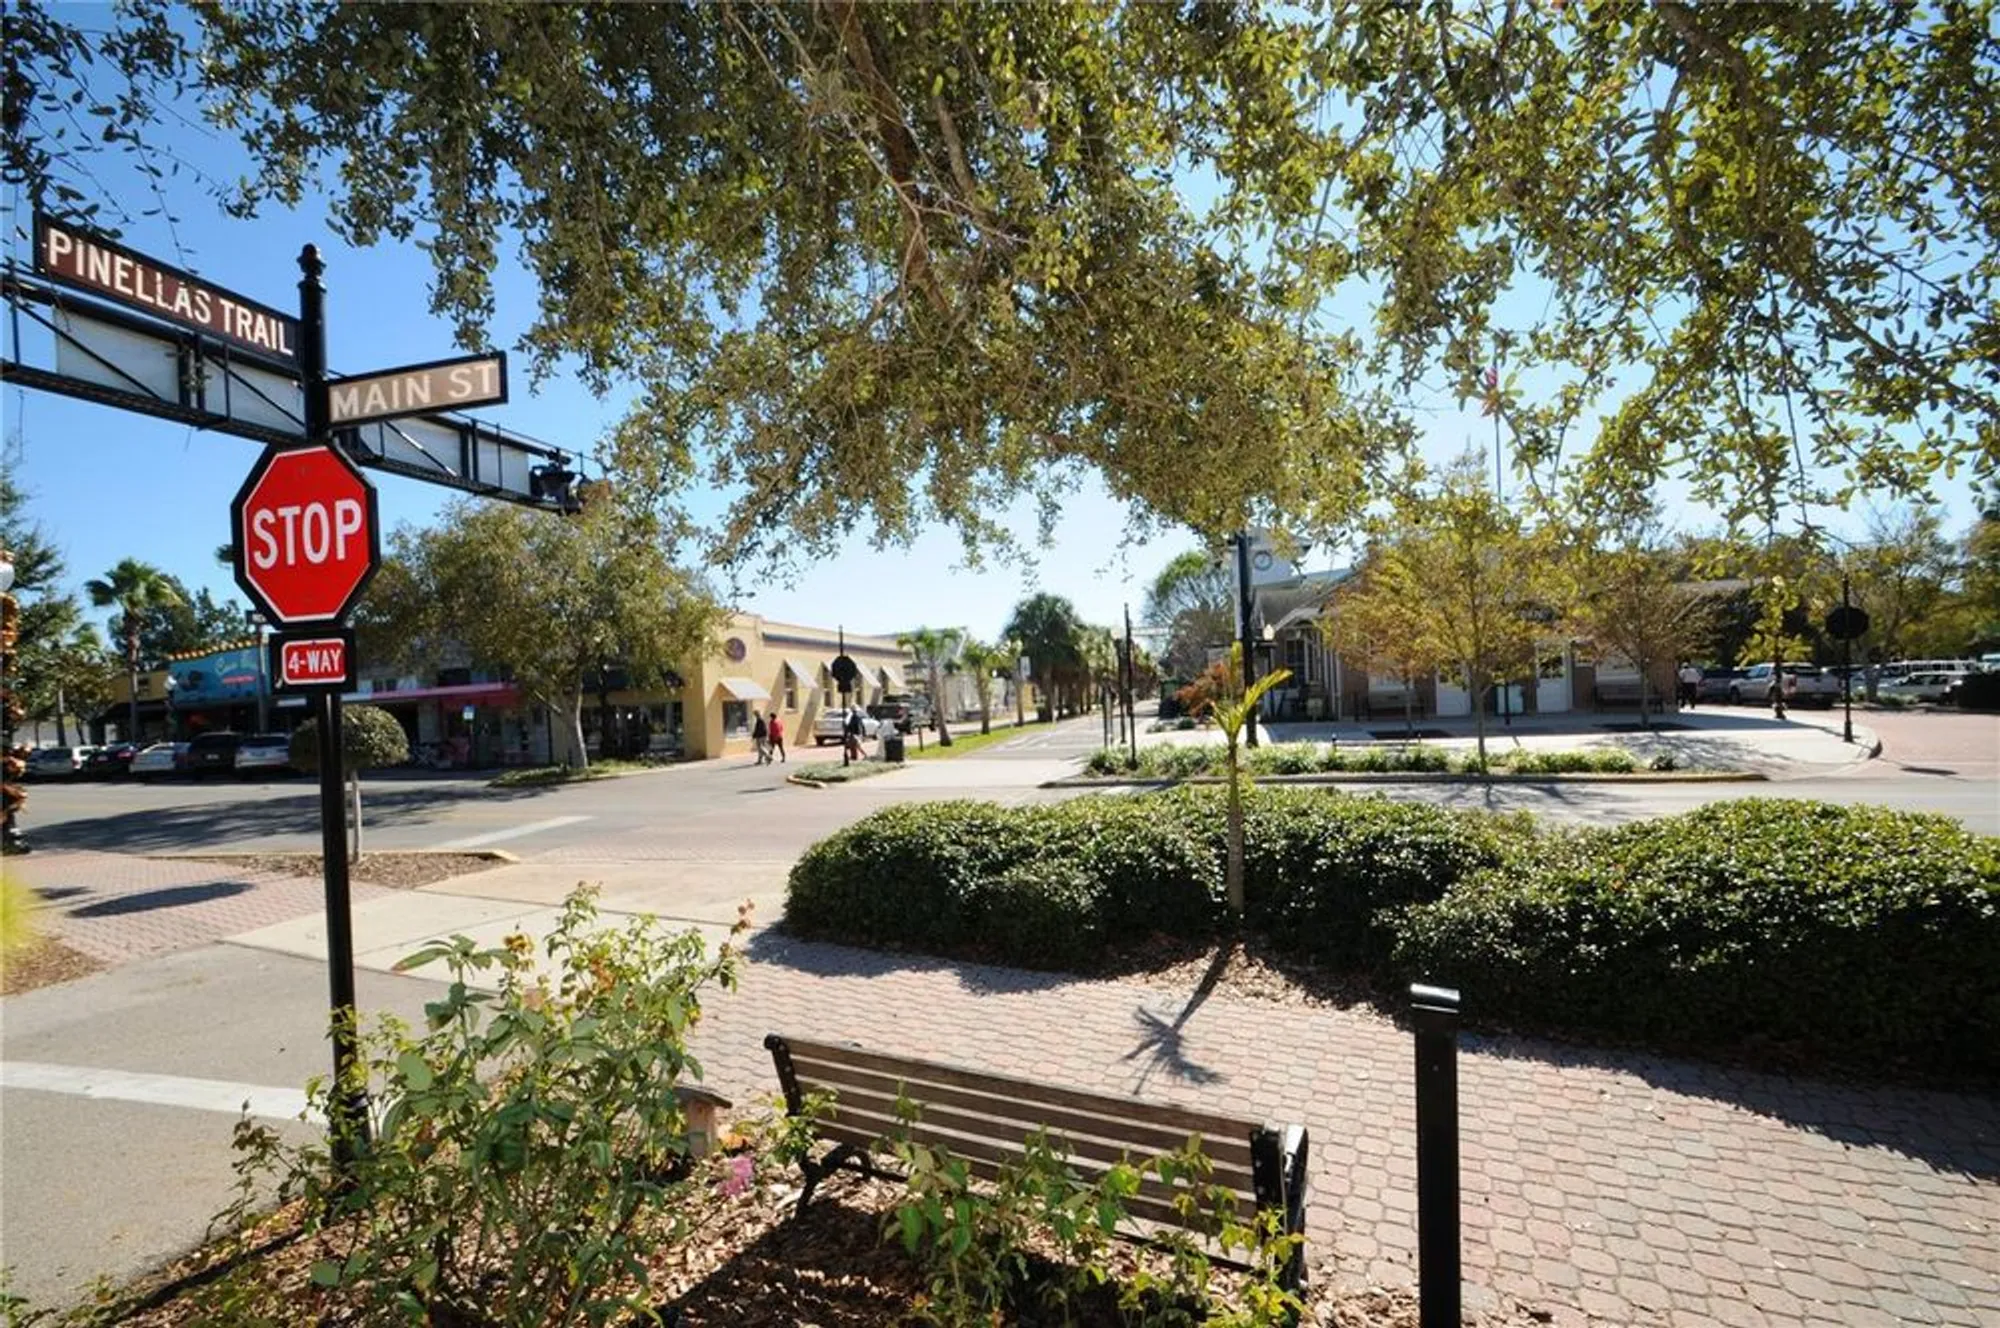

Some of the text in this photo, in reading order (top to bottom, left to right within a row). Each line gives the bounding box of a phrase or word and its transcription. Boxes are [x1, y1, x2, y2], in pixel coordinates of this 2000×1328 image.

[49, 228, 293, 356] PINELLAS TRAIL
[331, 361, 498, 419] MAIN ST
[253, 498, 362, 569] STOP
[288, 649, 342, 673] 4-WAY
